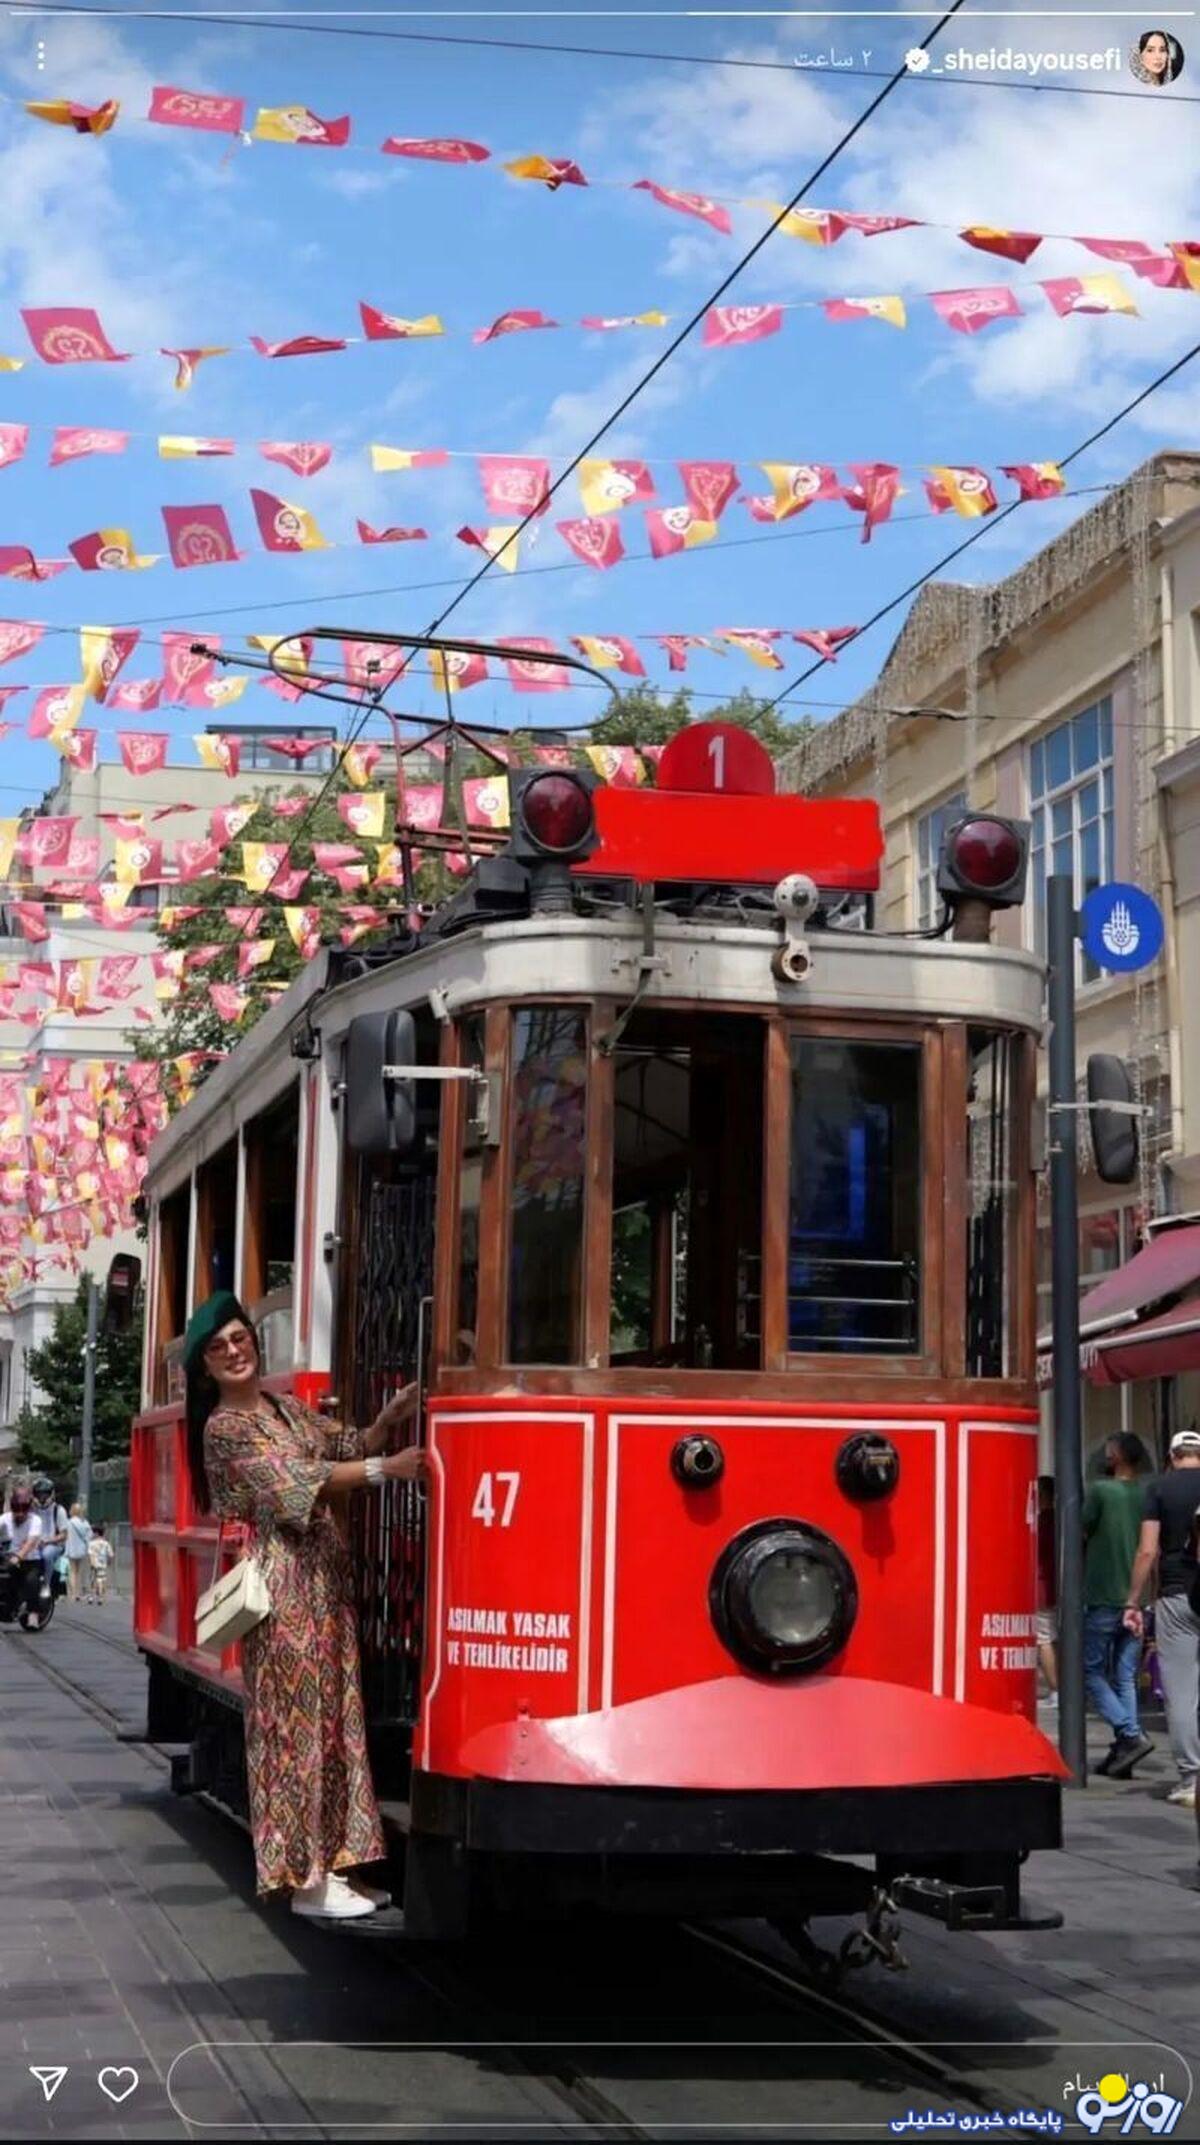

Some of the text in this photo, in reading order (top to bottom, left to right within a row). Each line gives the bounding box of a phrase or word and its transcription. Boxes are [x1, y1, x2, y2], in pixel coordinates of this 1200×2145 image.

[708, 735, 725, 789] 1
[471, 1471, 521, 1528] 47
[448, 1607, 571, 1639] ASILMAK YASAK
[447, 1641, 569, 1673] VE TEHLİKELİDİR
[980, 1646, 998, 1670] VE
